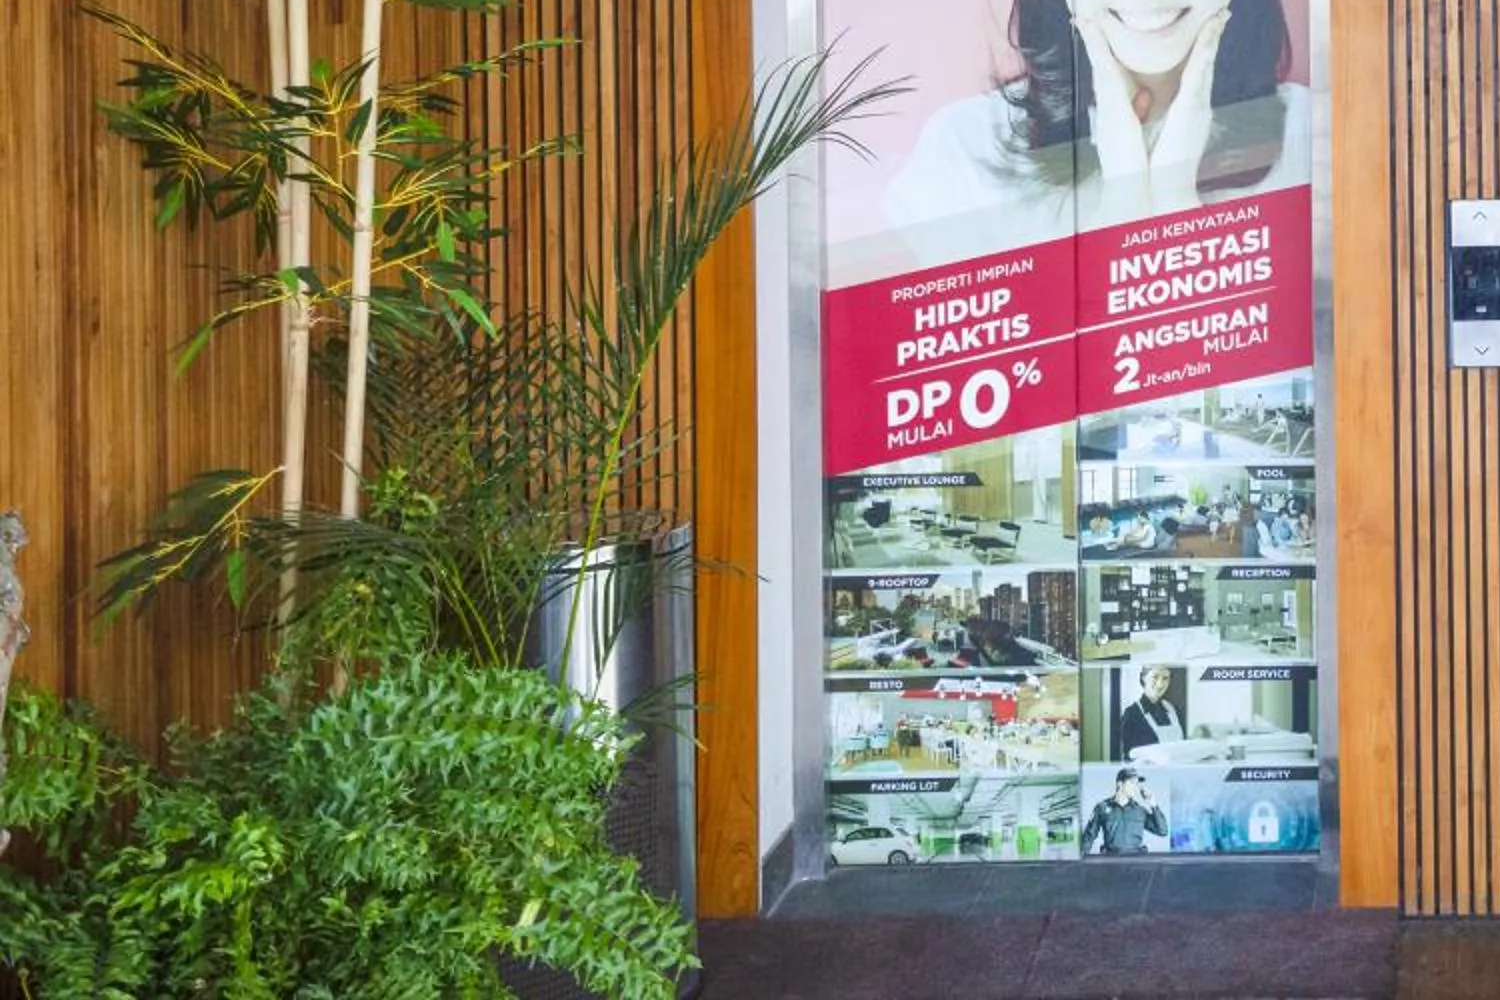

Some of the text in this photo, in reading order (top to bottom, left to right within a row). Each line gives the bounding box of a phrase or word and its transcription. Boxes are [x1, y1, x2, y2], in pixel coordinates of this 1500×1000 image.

[1121, 205, 1260, 249] JADI KENYATAAN
[1109, 226, 1270, 284] INVESTASI
[891, 257, 1034, 302] PROPERTI IMPIAN
[1107, 256, 1273, 315] EKONOMIS
[915, 287, 1012, 331] HIDUP
[897, 314, 1030, 366] PRAKTIS
[1113, 304, 1268, 357] ANGSURAN
[1202, 328, 1269, 356] MULAI
[887, 380, 951, 426] DP
[887, 418, 953, 450] MULAI
[863, 475, 966, 487] EXECUTIVE LOUNGE
[1256, 469, 1286, 478] POOL
[1231, 568, 1291, 578] RECEPTION
[1213, 669, 1291, 679] ROOM SERVICE
[870, 781, 939, 792] PARKING LOT
[1241, 770, 1291, 779] SECURITY
